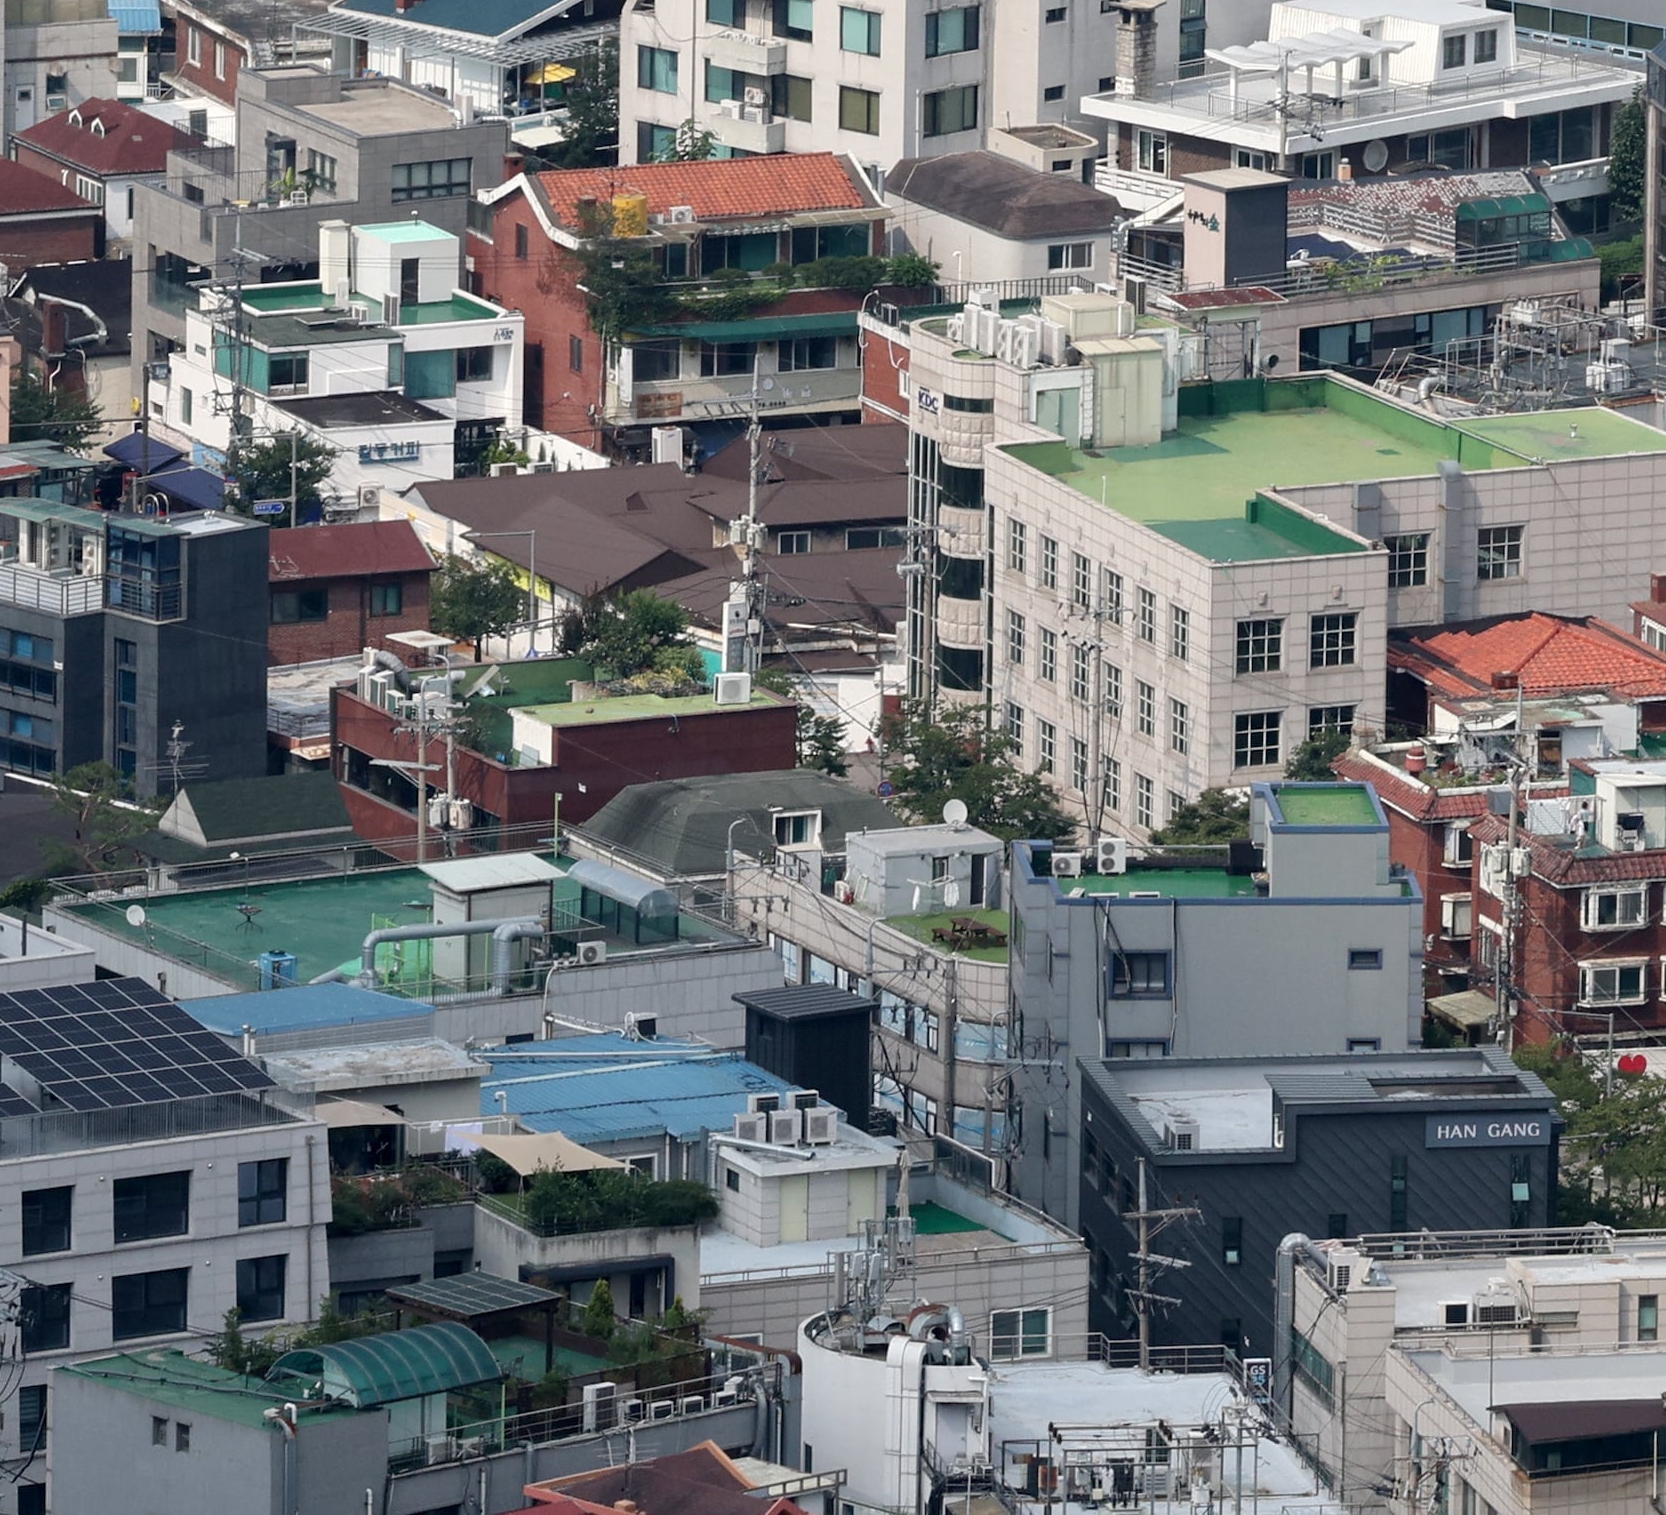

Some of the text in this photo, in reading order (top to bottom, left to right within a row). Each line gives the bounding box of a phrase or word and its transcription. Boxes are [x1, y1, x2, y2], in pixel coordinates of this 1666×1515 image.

[918, 390, 939, 412] KDC
[1437, 1122, 1541, 1140] HAN GANG
[1250, 1365, 1267, 1375] GS
